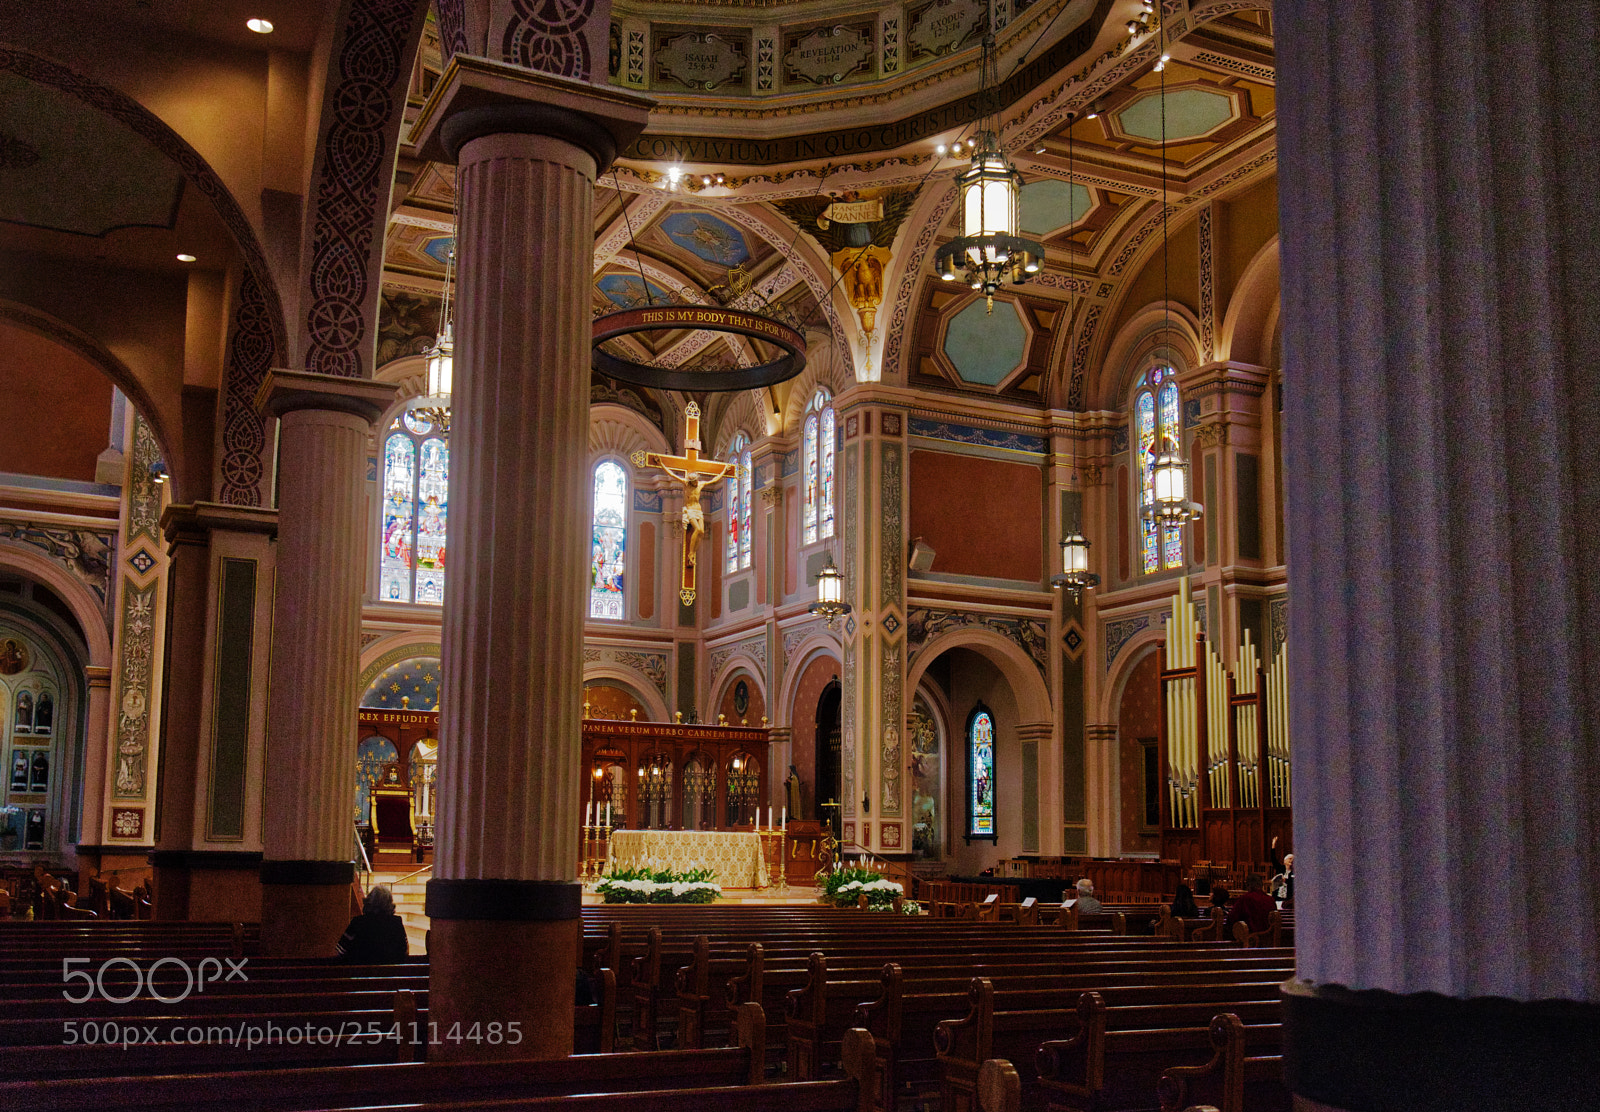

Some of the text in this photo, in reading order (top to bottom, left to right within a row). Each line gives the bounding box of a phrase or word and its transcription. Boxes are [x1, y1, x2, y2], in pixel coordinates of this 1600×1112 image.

[930, 10, 965, 30] EXODUS
[685, 53, 718, 62] ISAIAH
[800, 43, 858, 59] REVELATION
[636, 138, 779, 161] CONVIVIUM!
[795, 139, 816, 157] IN
[824, 131, 872, 157] QUO
[880, 100, 977, 146] CHRISTUS
[833, 203, 876, 212] SANCTUS
[642, 311, 793, 342] THIS IS MY BODY THAT IS FOR YOU
[359, 713, 379, 721] REX
[383, 714, 430, 723] EFFUDIT
[583, 724, 763, 740] PANEM VERUM VERBO CARNEM EFFICIT
